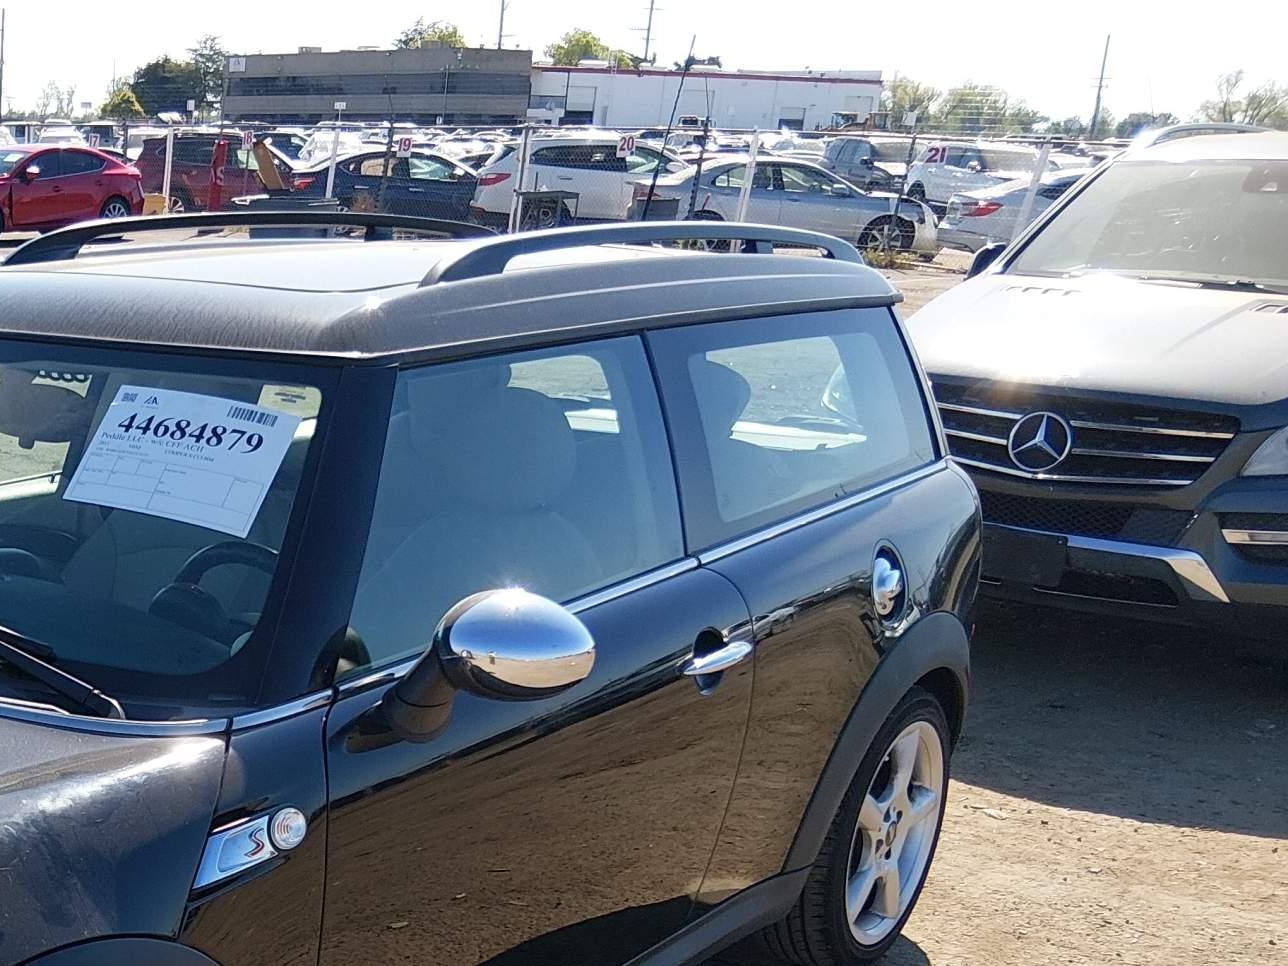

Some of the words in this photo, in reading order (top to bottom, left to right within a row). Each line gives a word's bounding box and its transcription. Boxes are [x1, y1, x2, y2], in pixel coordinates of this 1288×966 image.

[399, 137, 412, 152] 19
[619, 136, 635, 152] 20
[924, 147, 947, 163] 21
[117, 412, 264, 454] 44684879
[244, 826, 266, 858] S
